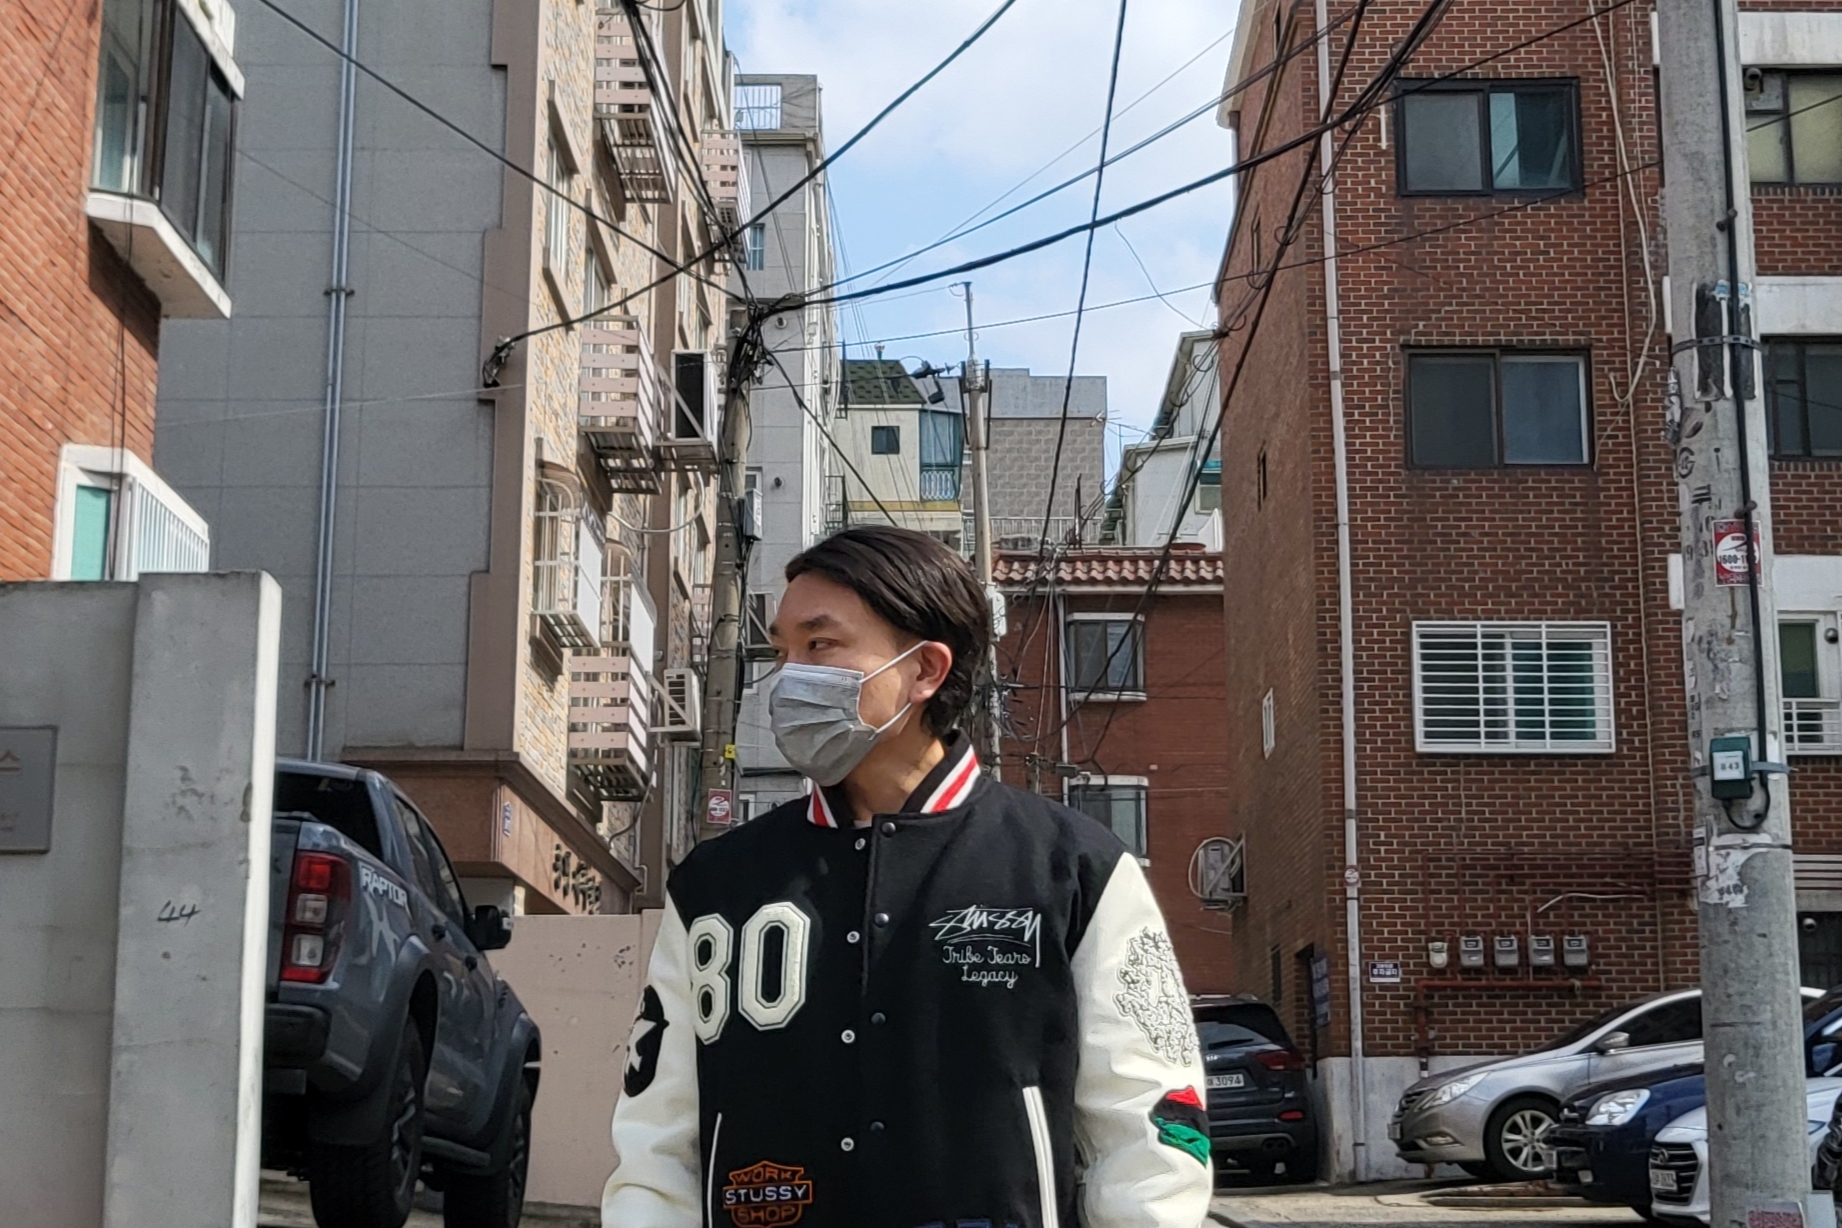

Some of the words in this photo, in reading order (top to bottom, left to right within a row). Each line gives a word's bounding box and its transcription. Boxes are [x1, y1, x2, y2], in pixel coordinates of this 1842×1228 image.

[360, 866, 408, 907] RAPTOR
[942, 945, 985, 964] Tribe
[986, 945, 1032, 964] Tears
[688, 901, 811, 1045] 80
[961, 964, 1019, 989] Legacy
[1215, 1075, 1242, 1087] 3094
[735, 1166, 793, 1183] WORK
[725, 1184, 807, 1205] STUSSY
[738, 1205, 796, 1223] SHOP
